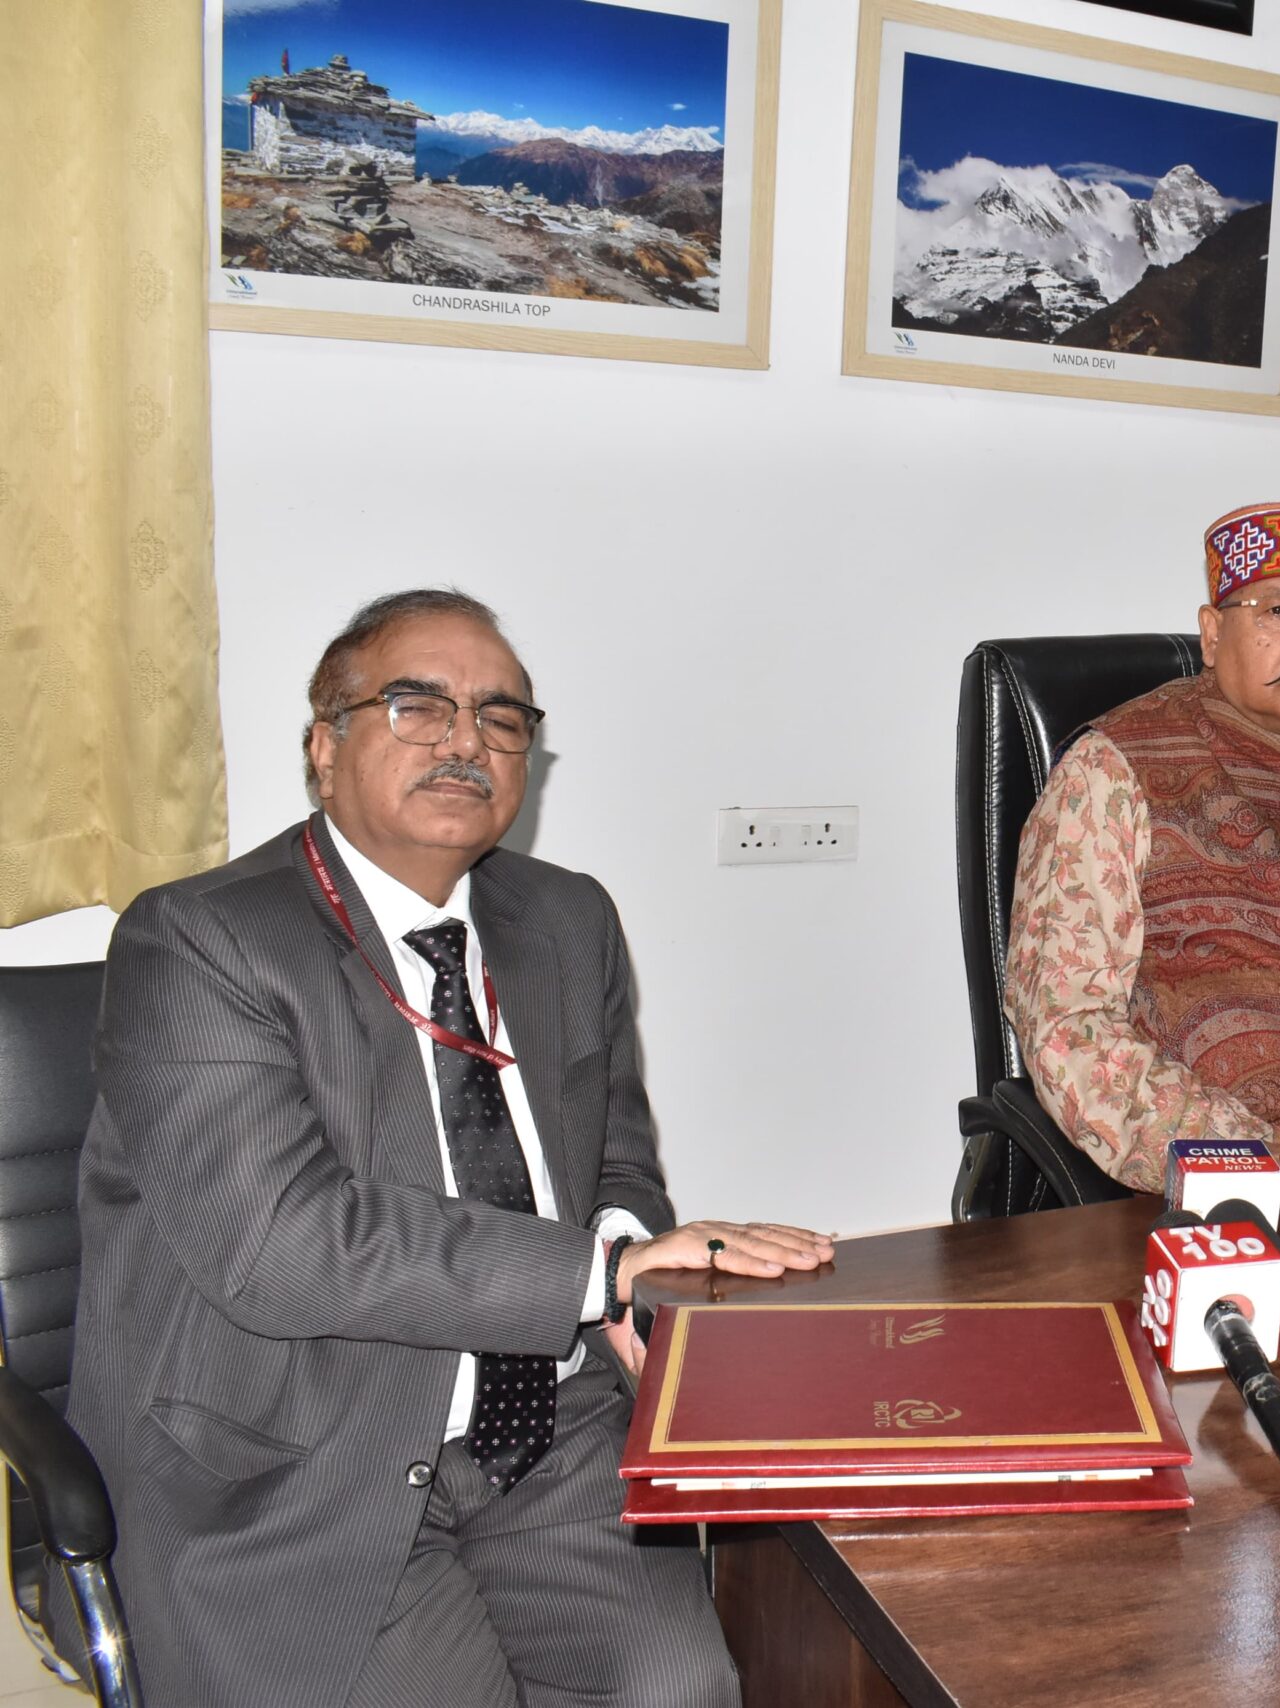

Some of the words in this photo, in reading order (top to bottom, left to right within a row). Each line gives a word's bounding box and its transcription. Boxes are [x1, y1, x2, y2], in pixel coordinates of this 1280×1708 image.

[412, 294, 521, 315] CHANDRASHILA
[525, 304, 551, 317] TOP
[1053, 353, 1089, 367] NANDA
[1092, 357, 1116, 369] DEVI
[1184, 1156, 1267, 1165] PATROL
[1188, 1148, 1254, 1156] CRIME
[1168, 1224, 1222, 1243] TV
[1182, 1237, 1266, 1261] 100
[1141, 1275, 1158, 1329] TV
[1153, 1269, 1172, 1347] 100
[873, 1401, 891, 1428] IRCTC
